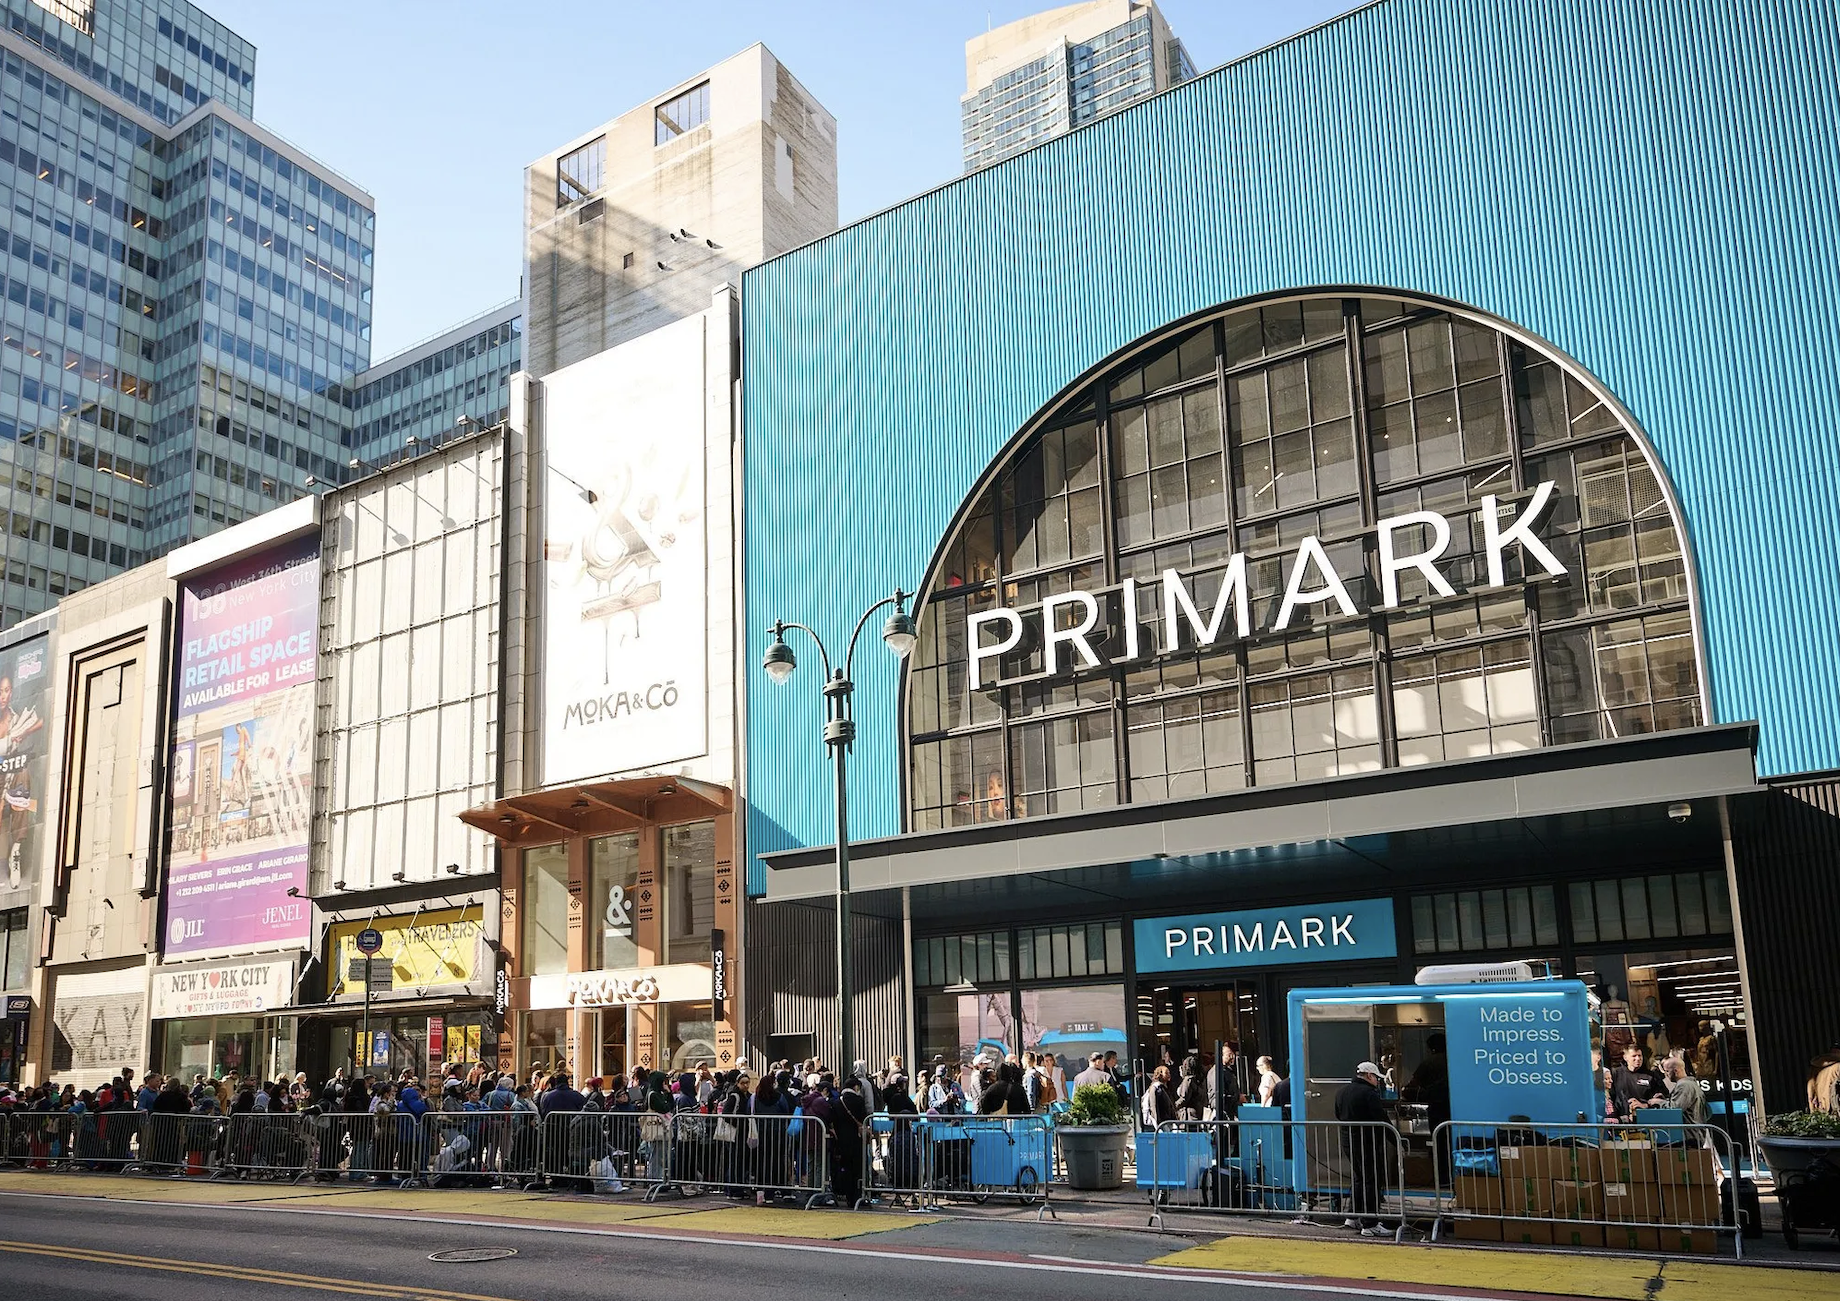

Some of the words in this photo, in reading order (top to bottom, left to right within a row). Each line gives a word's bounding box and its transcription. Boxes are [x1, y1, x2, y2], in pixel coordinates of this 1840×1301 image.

[230, 573, 256, 589] West
[285, 551, 317, 570] Street
[230, 594, 255, 609] New
[259, 581, 286, 597] York
[291, 568, 317, 587] City
[967, 480, 1569, 691] PRIMARK
[186, 615, 273, 661] FLAGSHIP
[185, 651, 246, 689] RETAIL
[249, 630, 311, 669] SPACE
[184, 679, 245, 708] AVAILABLE
[246, 671, 269, 690] FOR
[275, 657, 315, 682] LEASE
[232, 862, 253, 875] GRACE
[257, 857, 283, 870] ARIANE
[283, 853, 309, 866] GIRARD
[185, 919, 205, 938] JLL
[262, 904, 303, 925] JENEL
[1165, 914, 1357, 958] PRIMARK
[171, 973, 198, 992] NEW
[241, 966, 270, 987] CITY
[189, 992, 208, 1001] GIFTS
[216, 989, 249, 999] LUGGAGE
[59, 1003, 140, 1050] KAY
[1074, 1023, 1089, 1031] TAXI
[1480, 1006, 1536, 1023] Made
[1541, 1007, 1563, 1022] to
[1483, 1026, 1565, 1046] Impress.
[1474, 1048, 1538, 1065] Priced
[1544, 1049, 1566, 1065] to
[1488, 1068, 1568, 1085] Obsess.
[1716, 1078, 1753, 1091] KDS
